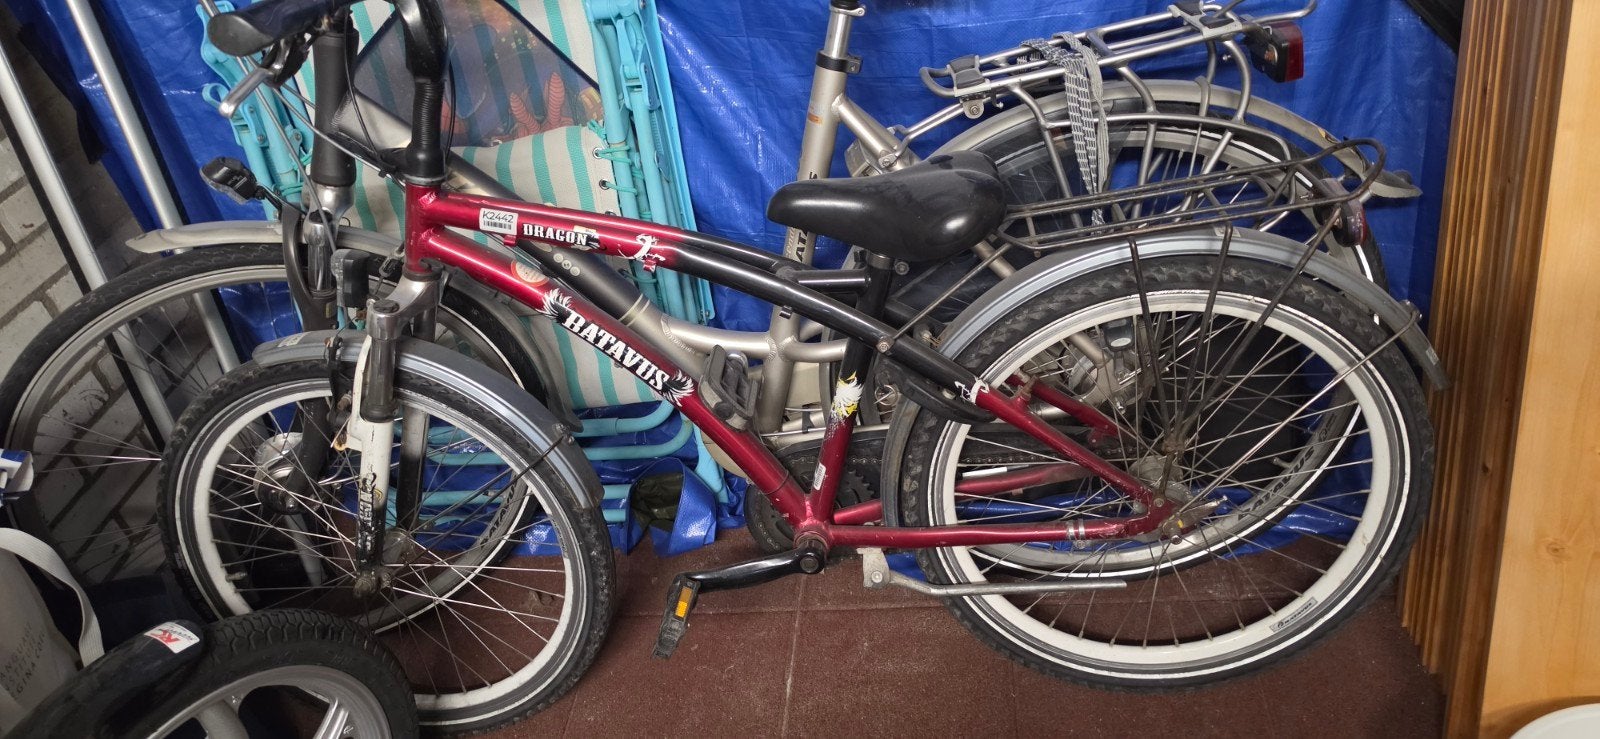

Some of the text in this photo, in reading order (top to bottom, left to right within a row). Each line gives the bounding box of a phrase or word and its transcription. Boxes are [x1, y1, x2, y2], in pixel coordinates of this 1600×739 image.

[482, 210, 514, 224] K2442
[522, 223, 588, 246] DRAGON
[561, 310, 670, 391] BATAVUS
